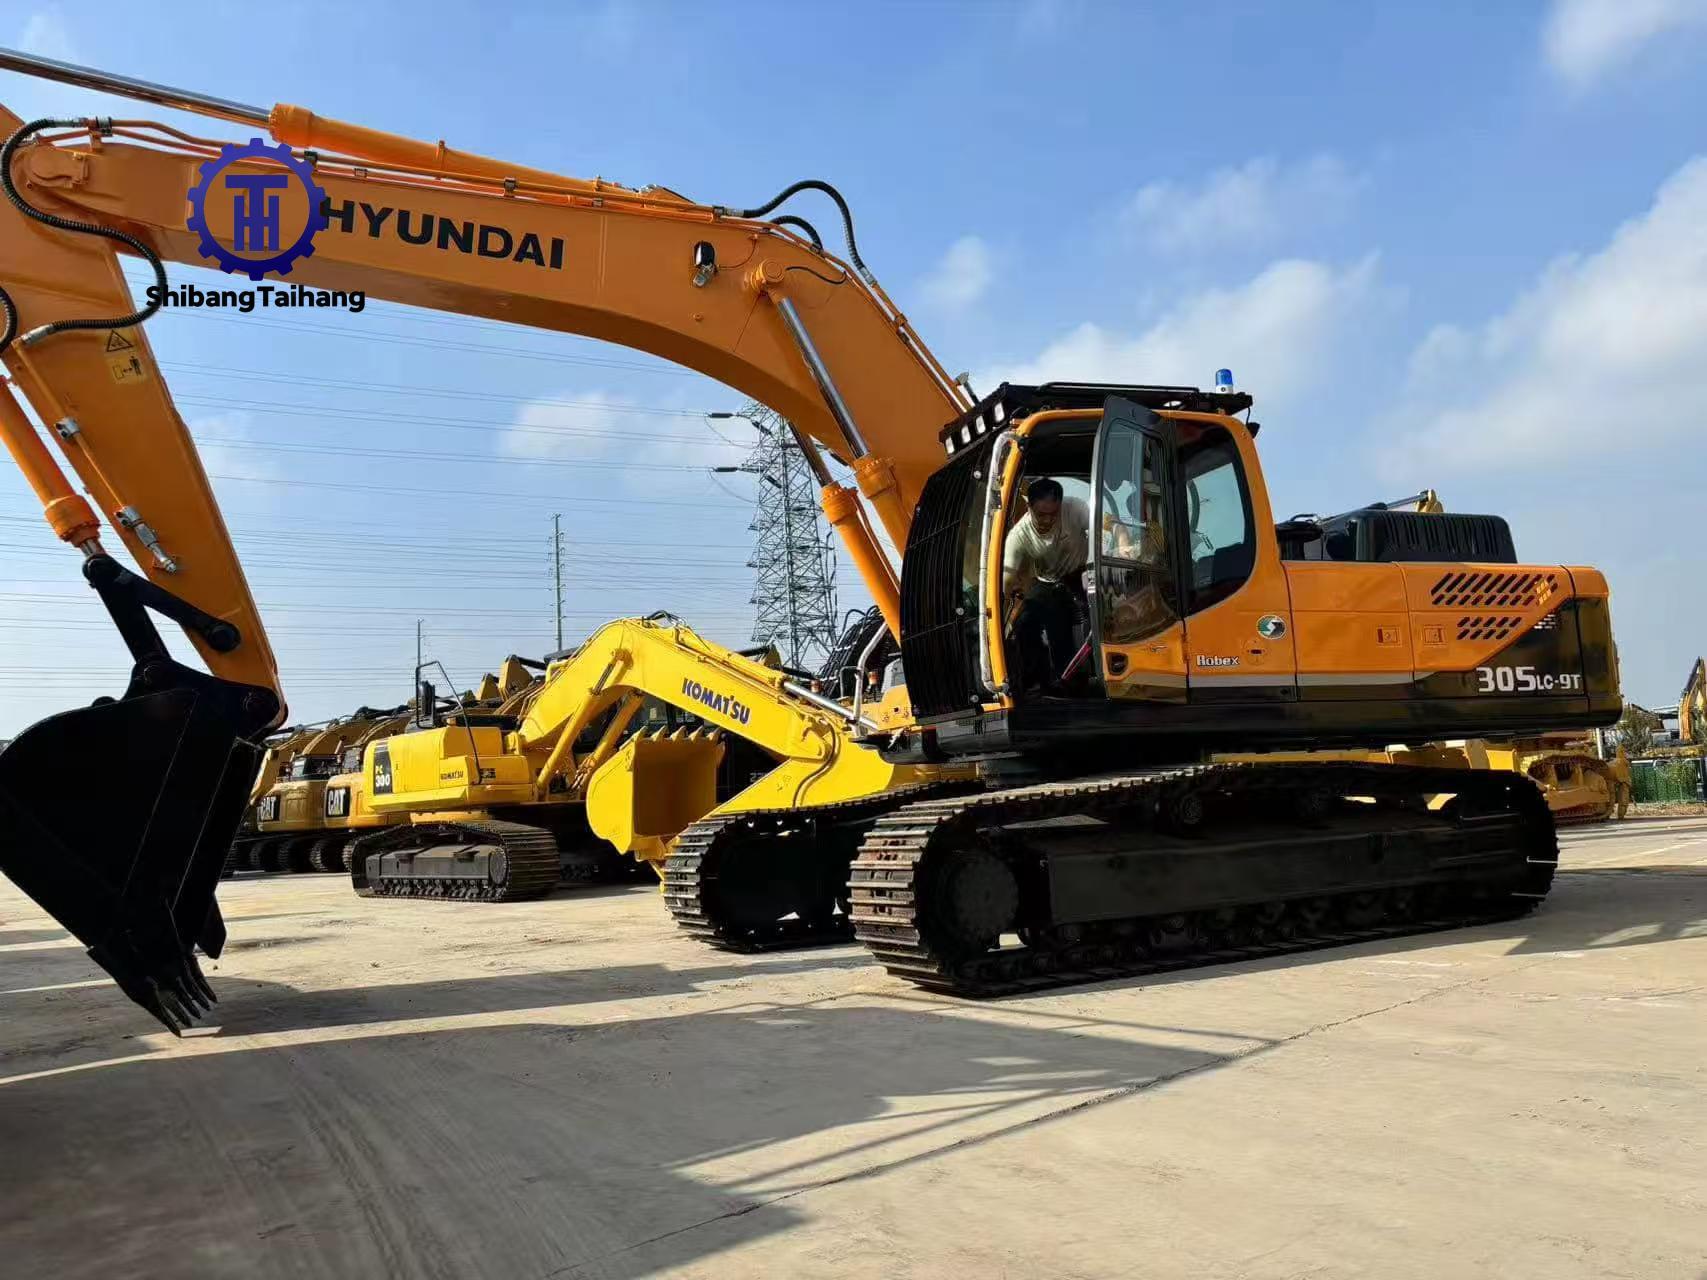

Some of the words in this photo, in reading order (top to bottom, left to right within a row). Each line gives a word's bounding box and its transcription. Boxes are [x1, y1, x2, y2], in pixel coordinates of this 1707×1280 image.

[319, 196, 564, 270] HYUNDAI
[1196, 654, 1239, 667] Robex
[375, 774, 391, 787] 300
[328, 788, 347, 815] CAT
